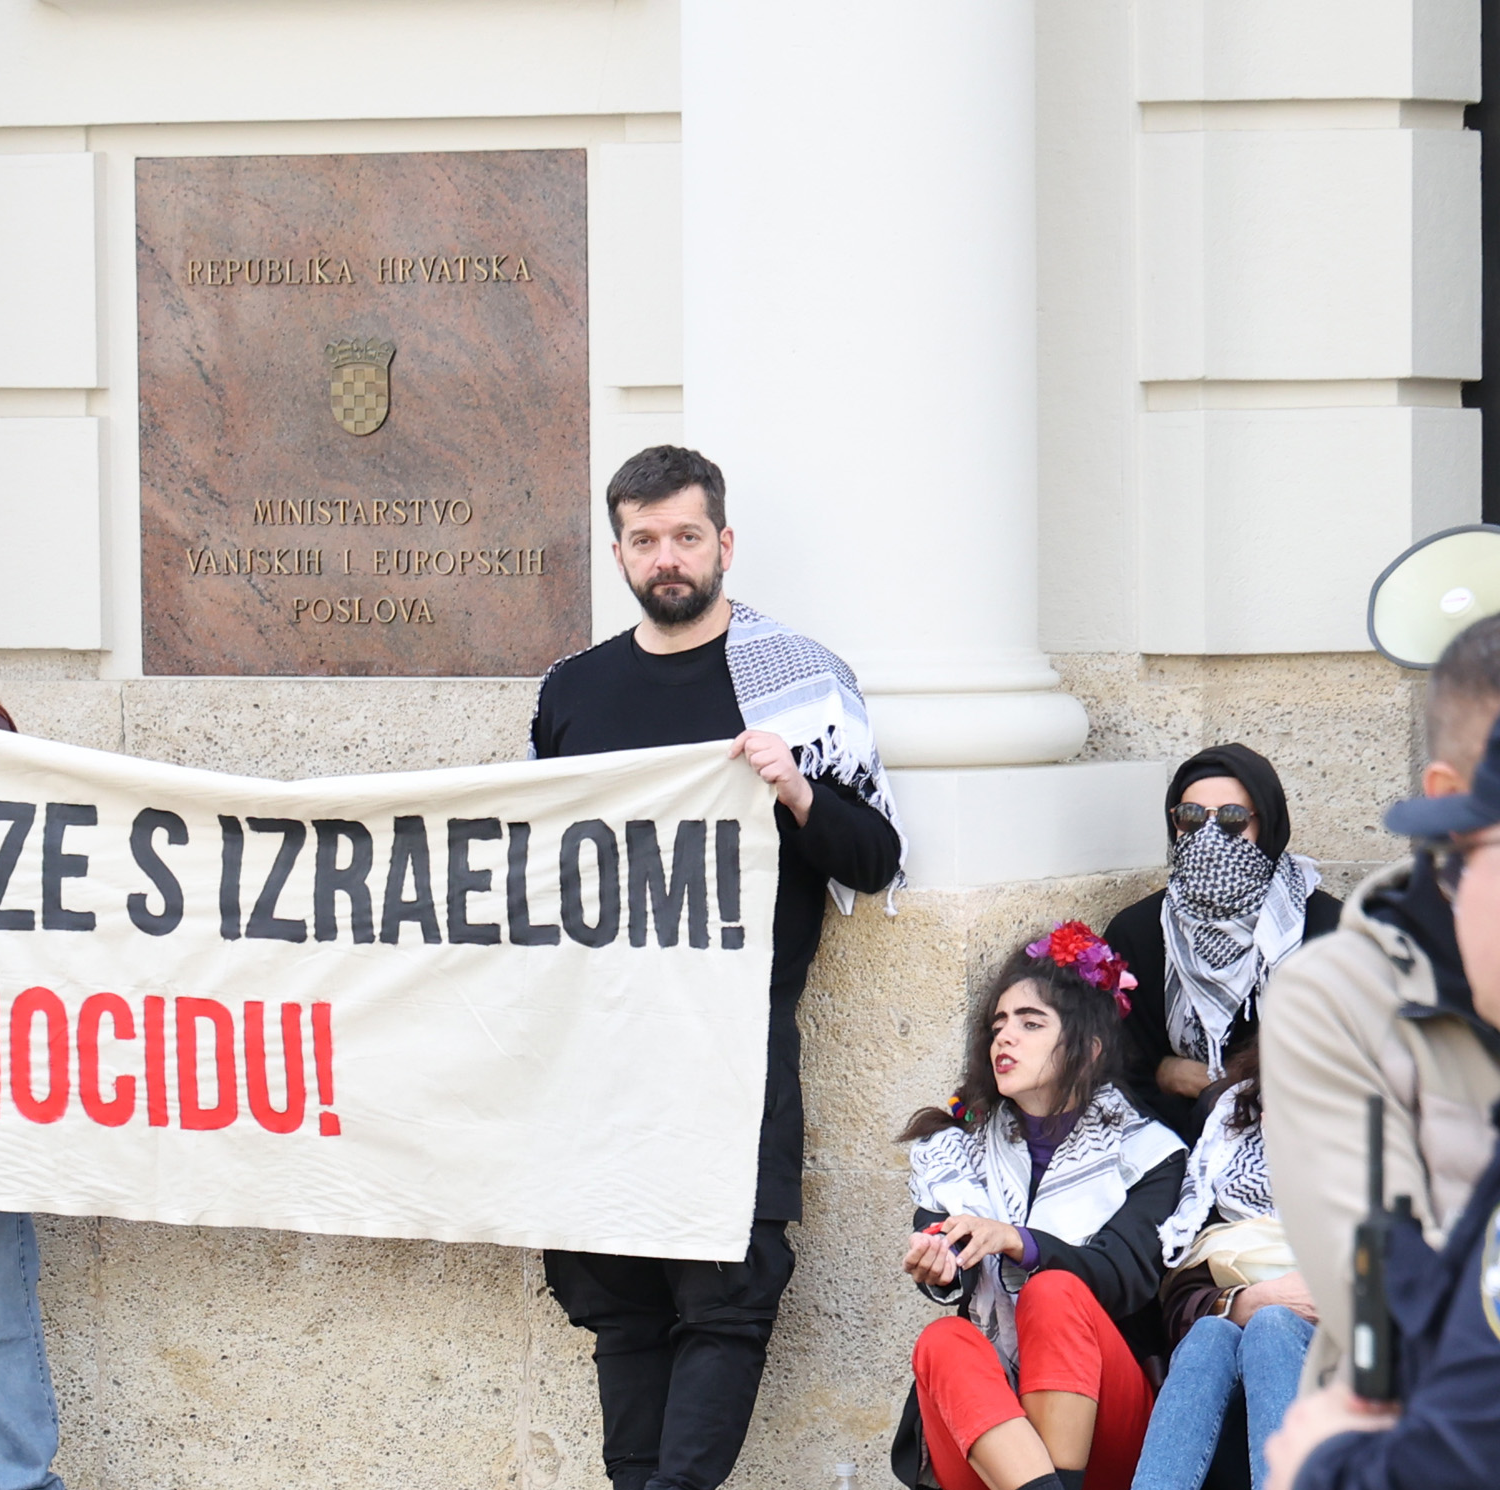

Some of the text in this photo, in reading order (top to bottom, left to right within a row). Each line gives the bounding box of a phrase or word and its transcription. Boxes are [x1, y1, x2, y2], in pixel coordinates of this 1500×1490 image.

[186, 254, 533, 286] REPUBLIKA HRVATSKA
[251, 498, 473, 527] MINISTARSTVO
[186, 547, 545, 577] VANJSKIH I EUROPSKIH
[292, 597, 435, 625] POSLOVA
[126, 806, 189, 936] S
[217, 814, 746, 950] IZRAELOM!
